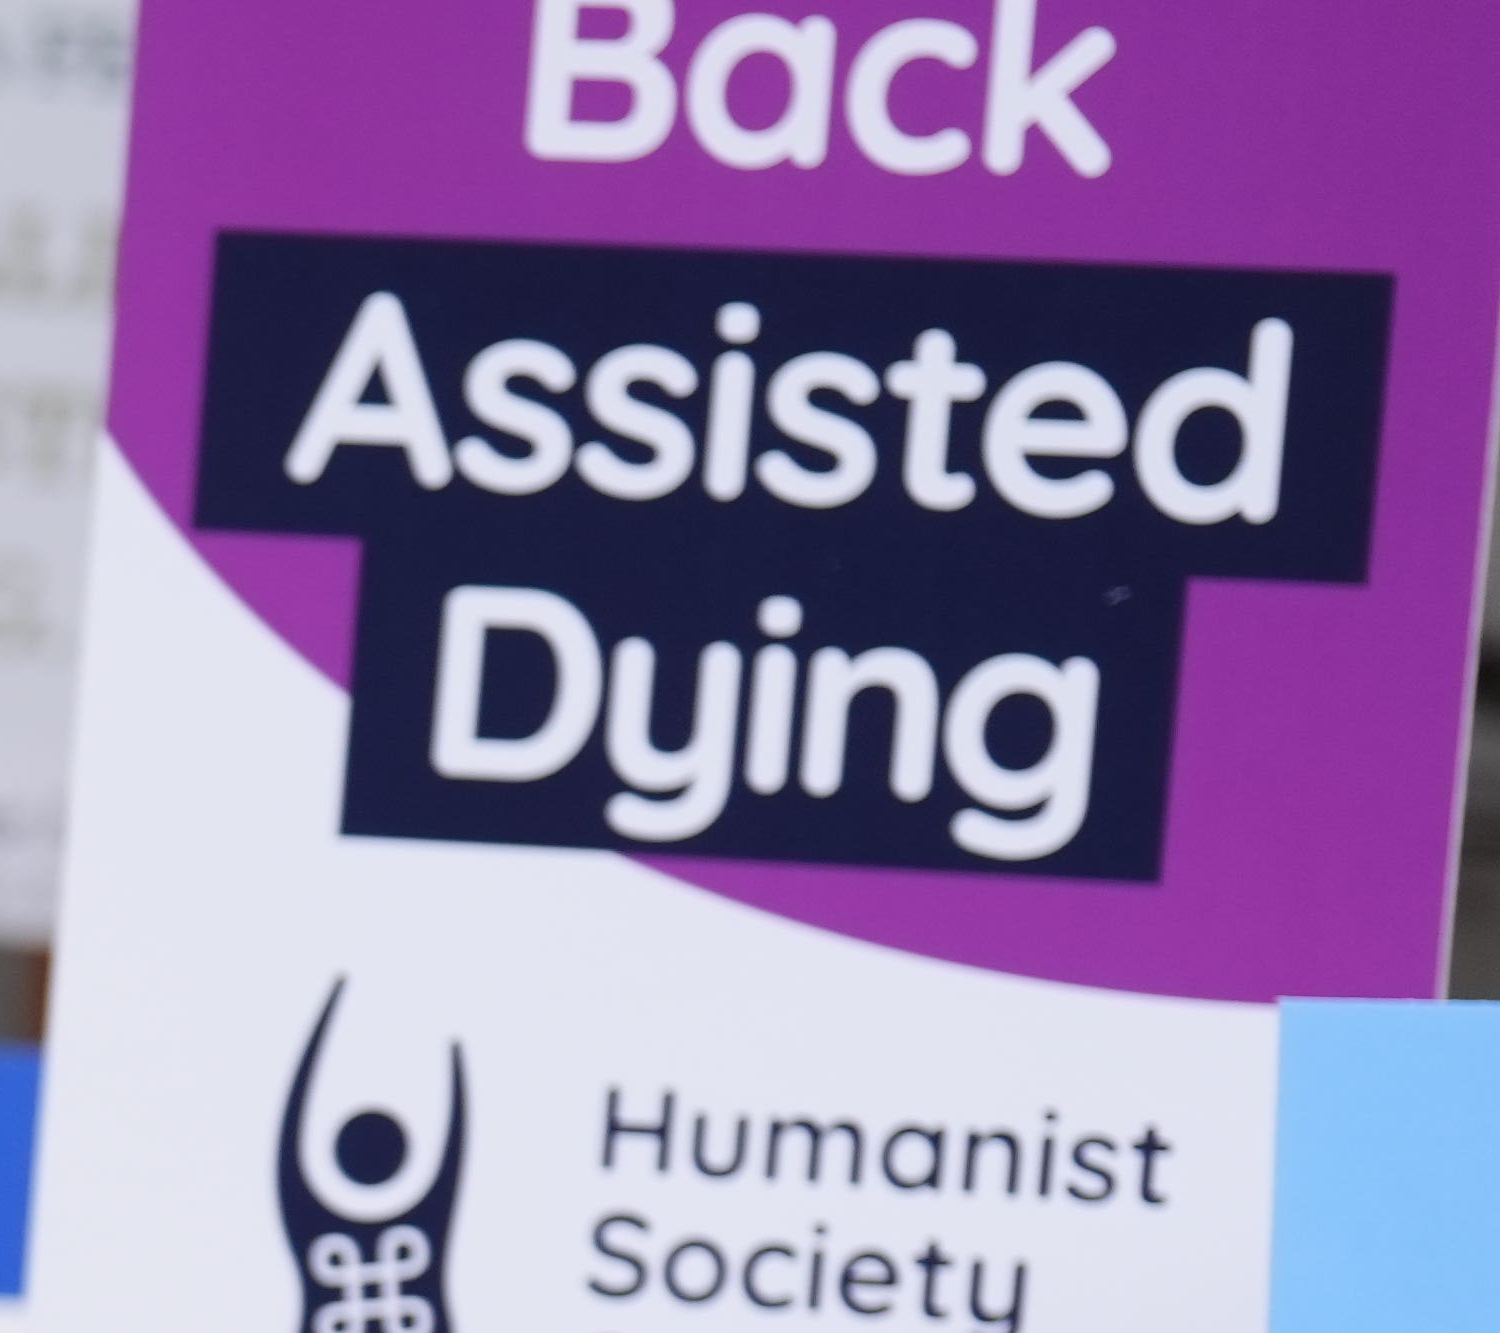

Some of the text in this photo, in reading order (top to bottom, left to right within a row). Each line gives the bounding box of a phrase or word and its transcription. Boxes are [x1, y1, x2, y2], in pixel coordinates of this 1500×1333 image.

[524, 0, 1117, 178] Back
[284, 290, 1294, 527] Assisted
[430, 583, 1101, 861] Dying
[599, 1085, 1174, 1207] Humanist
